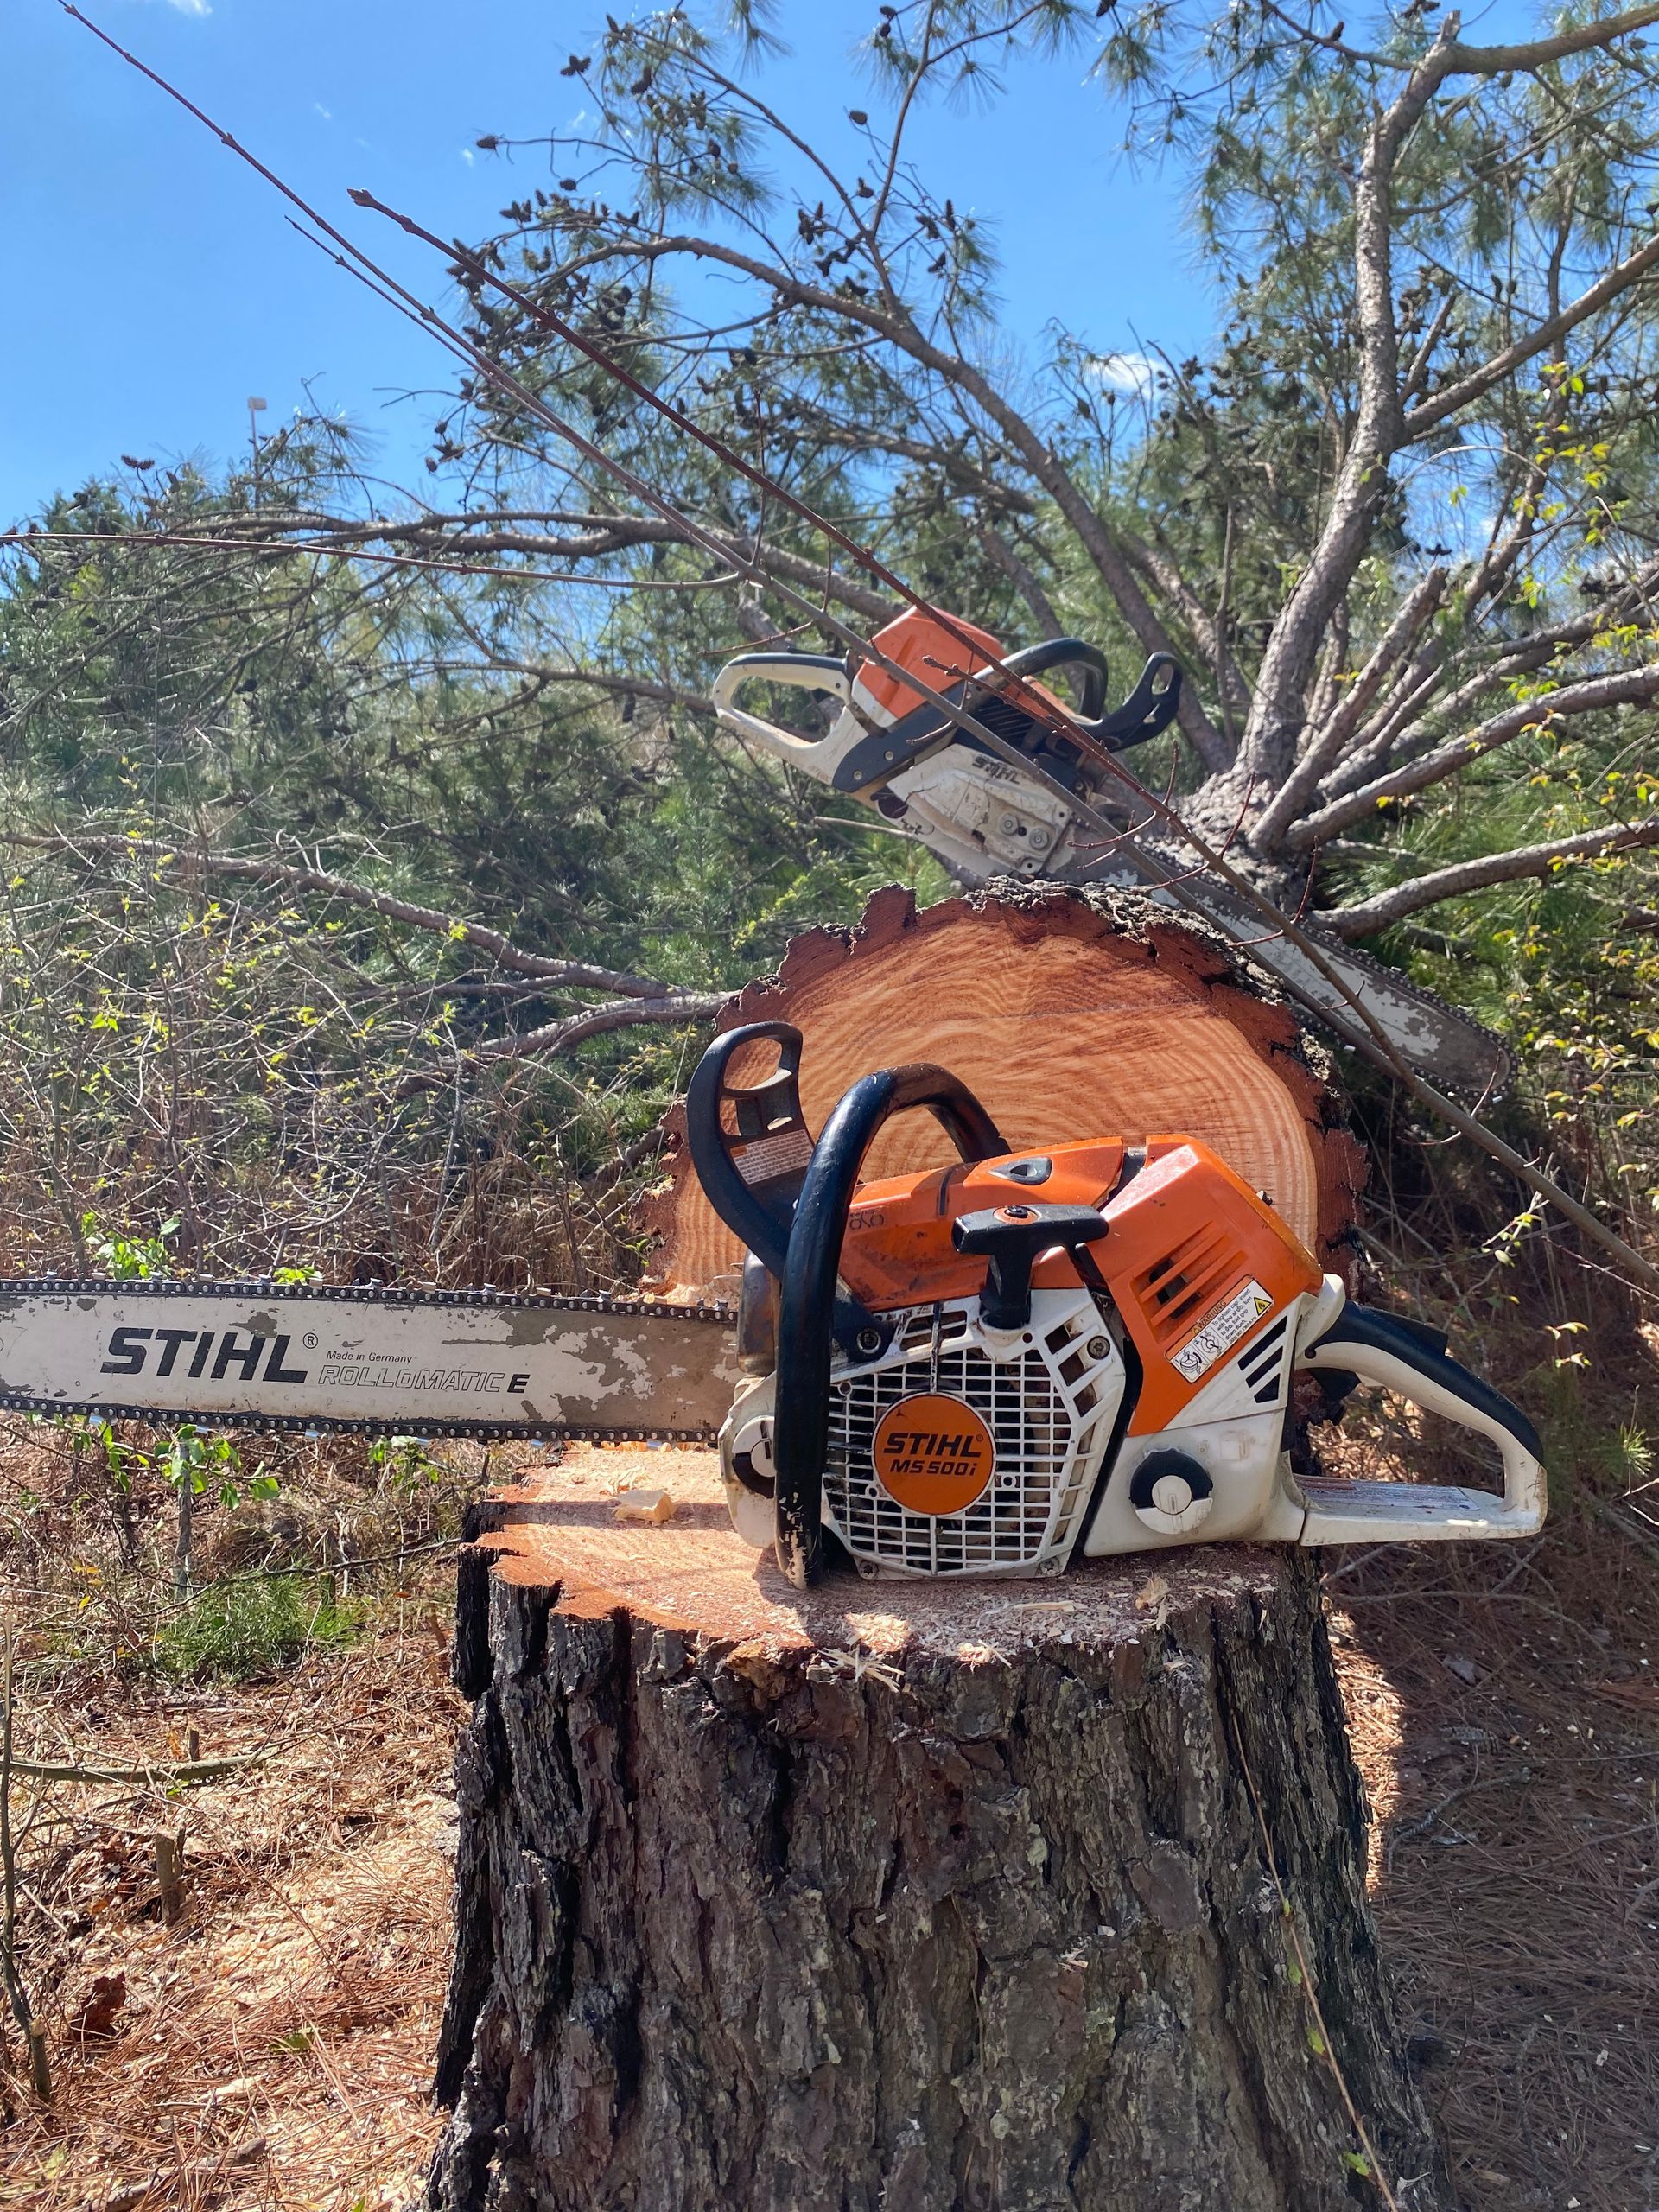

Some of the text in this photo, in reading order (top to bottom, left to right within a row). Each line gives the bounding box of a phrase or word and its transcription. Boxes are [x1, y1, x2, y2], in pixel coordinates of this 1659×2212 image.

[1197, 1300, 1227, 1329] WARNING
[1224, 1327, 1237, 1340] down
[327, 1351, 413, 1363] Made in Germany
[318, 1365, 531, 1393] ROLLOMATIC E
[890, 1459, 977, 1476] MS 500i
